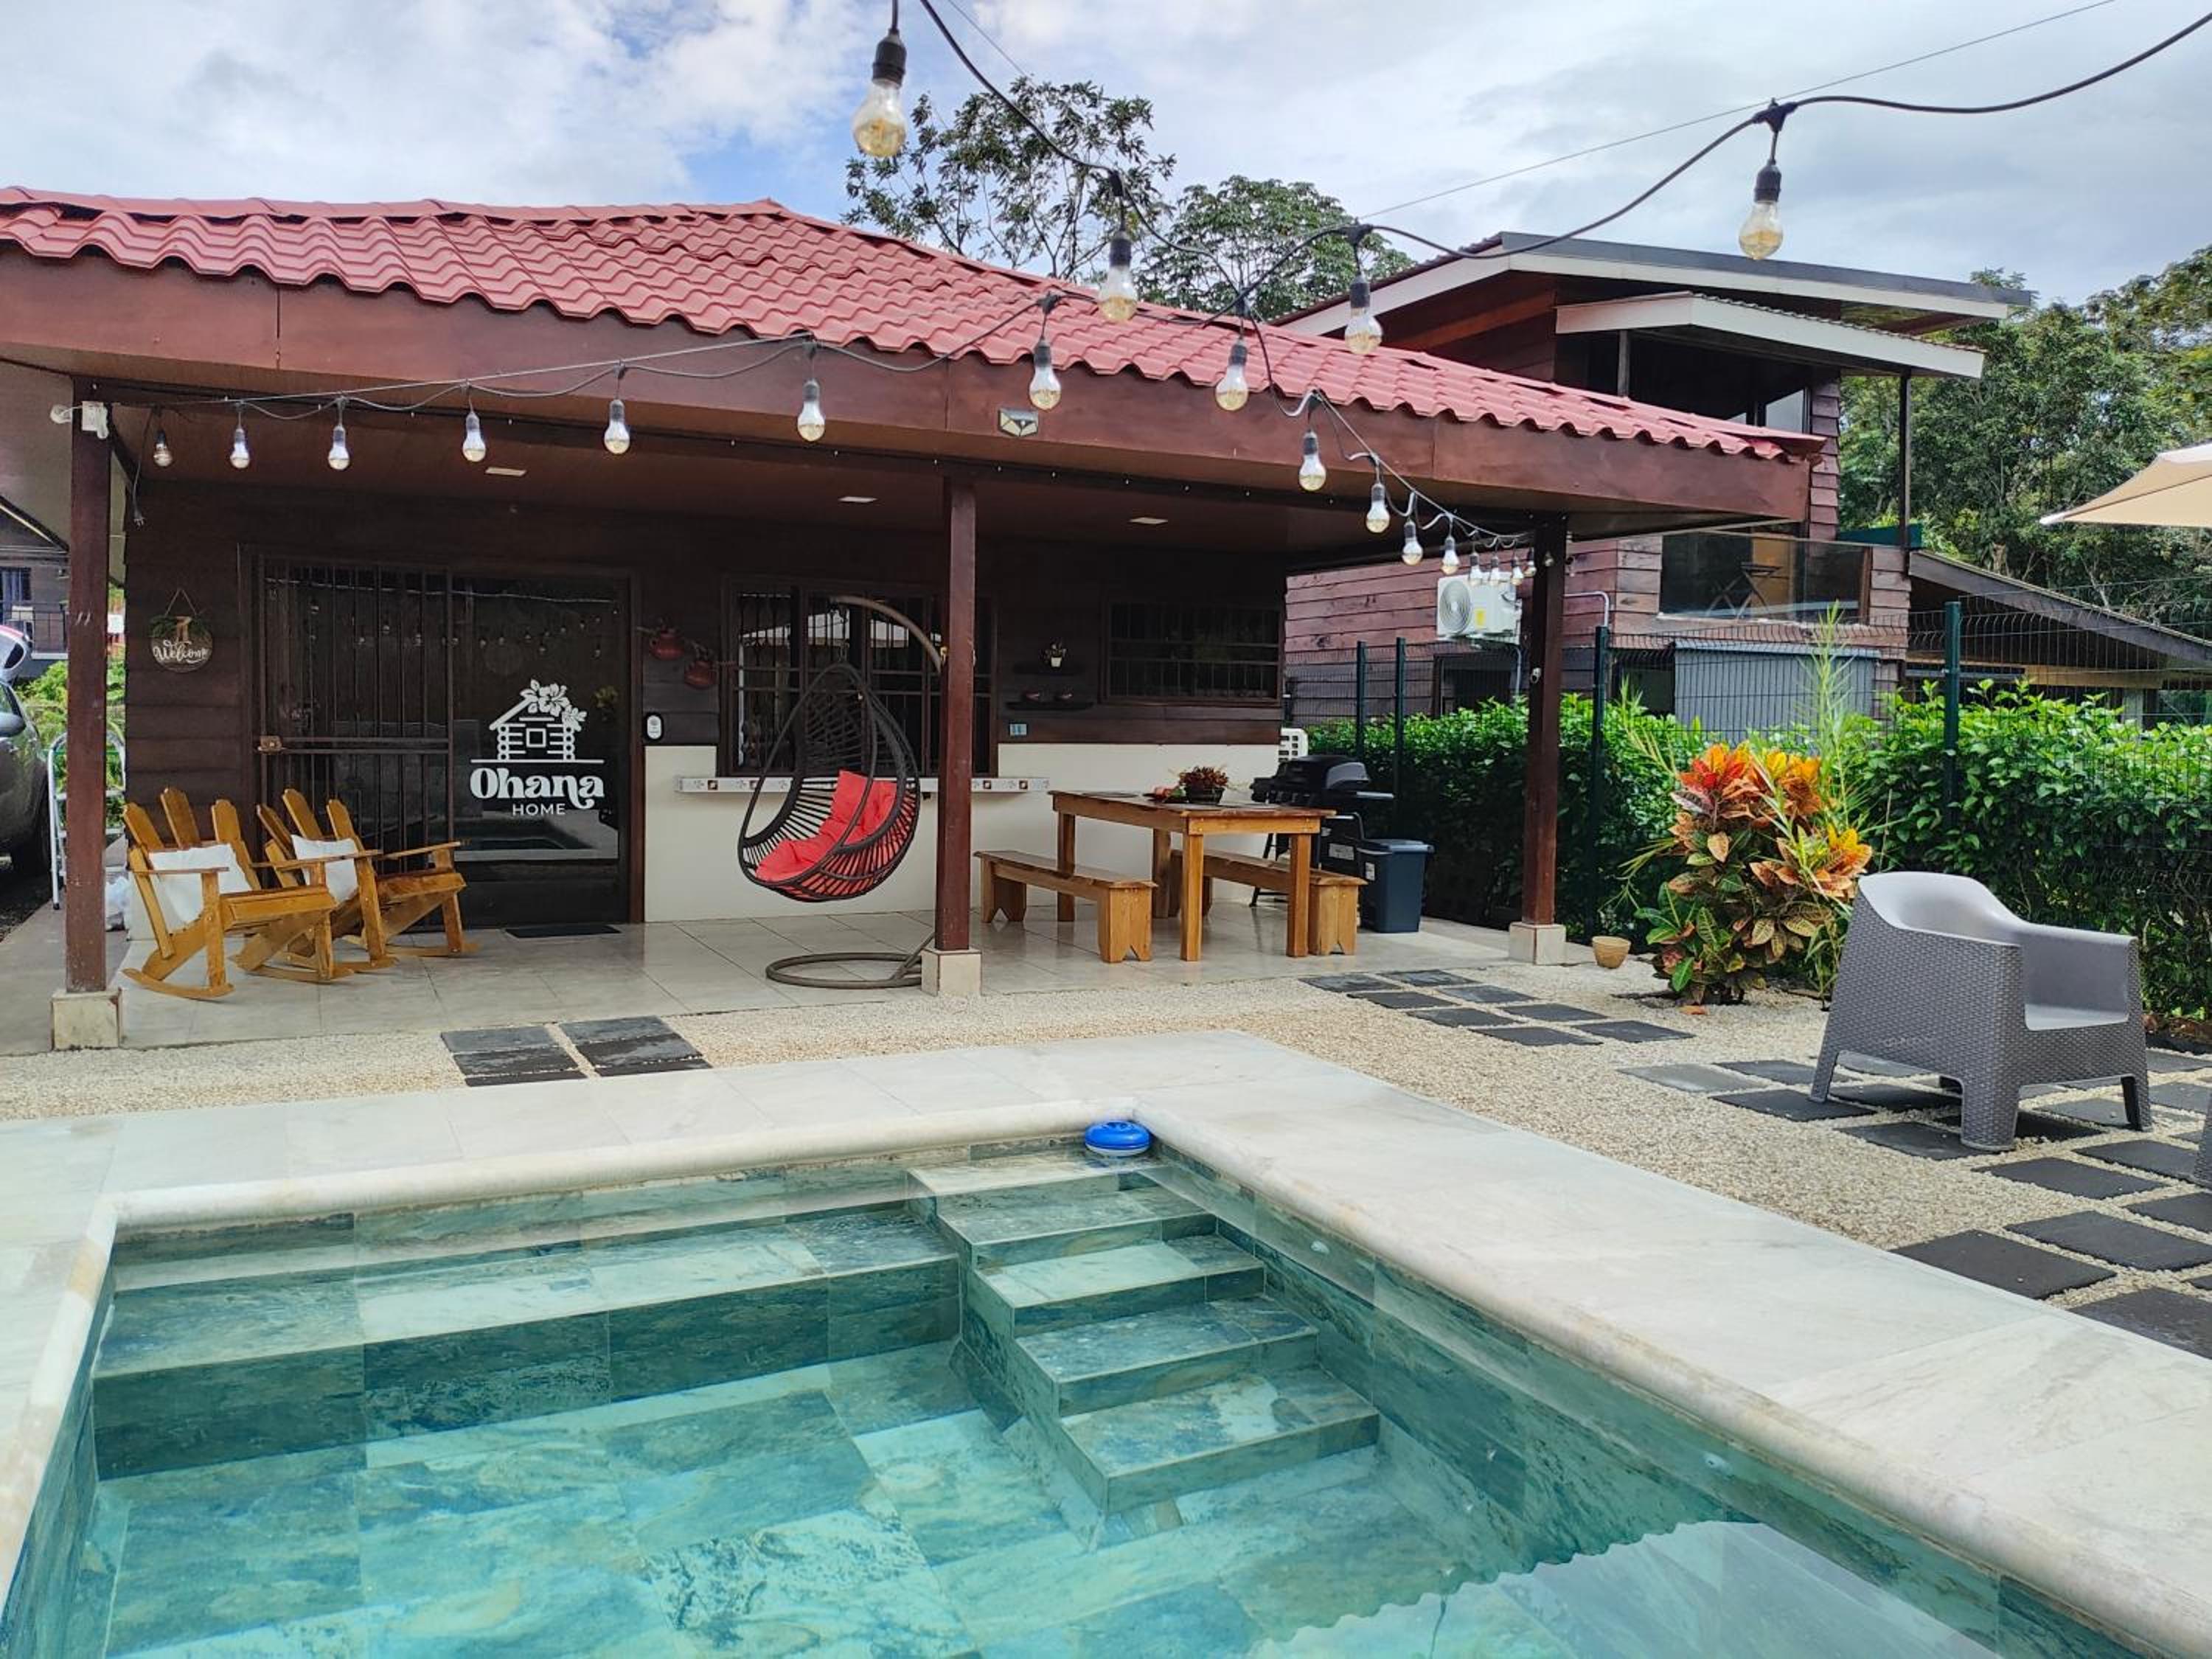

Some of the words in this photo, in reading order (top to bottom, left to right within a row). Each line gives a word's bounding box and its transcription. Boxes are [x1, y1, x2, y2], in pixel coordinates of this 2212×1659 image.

[153, 639, 209, 664] Welcome
[470, 768, 605, 809] Ohana
[512, 803, 566, 815] HOME
